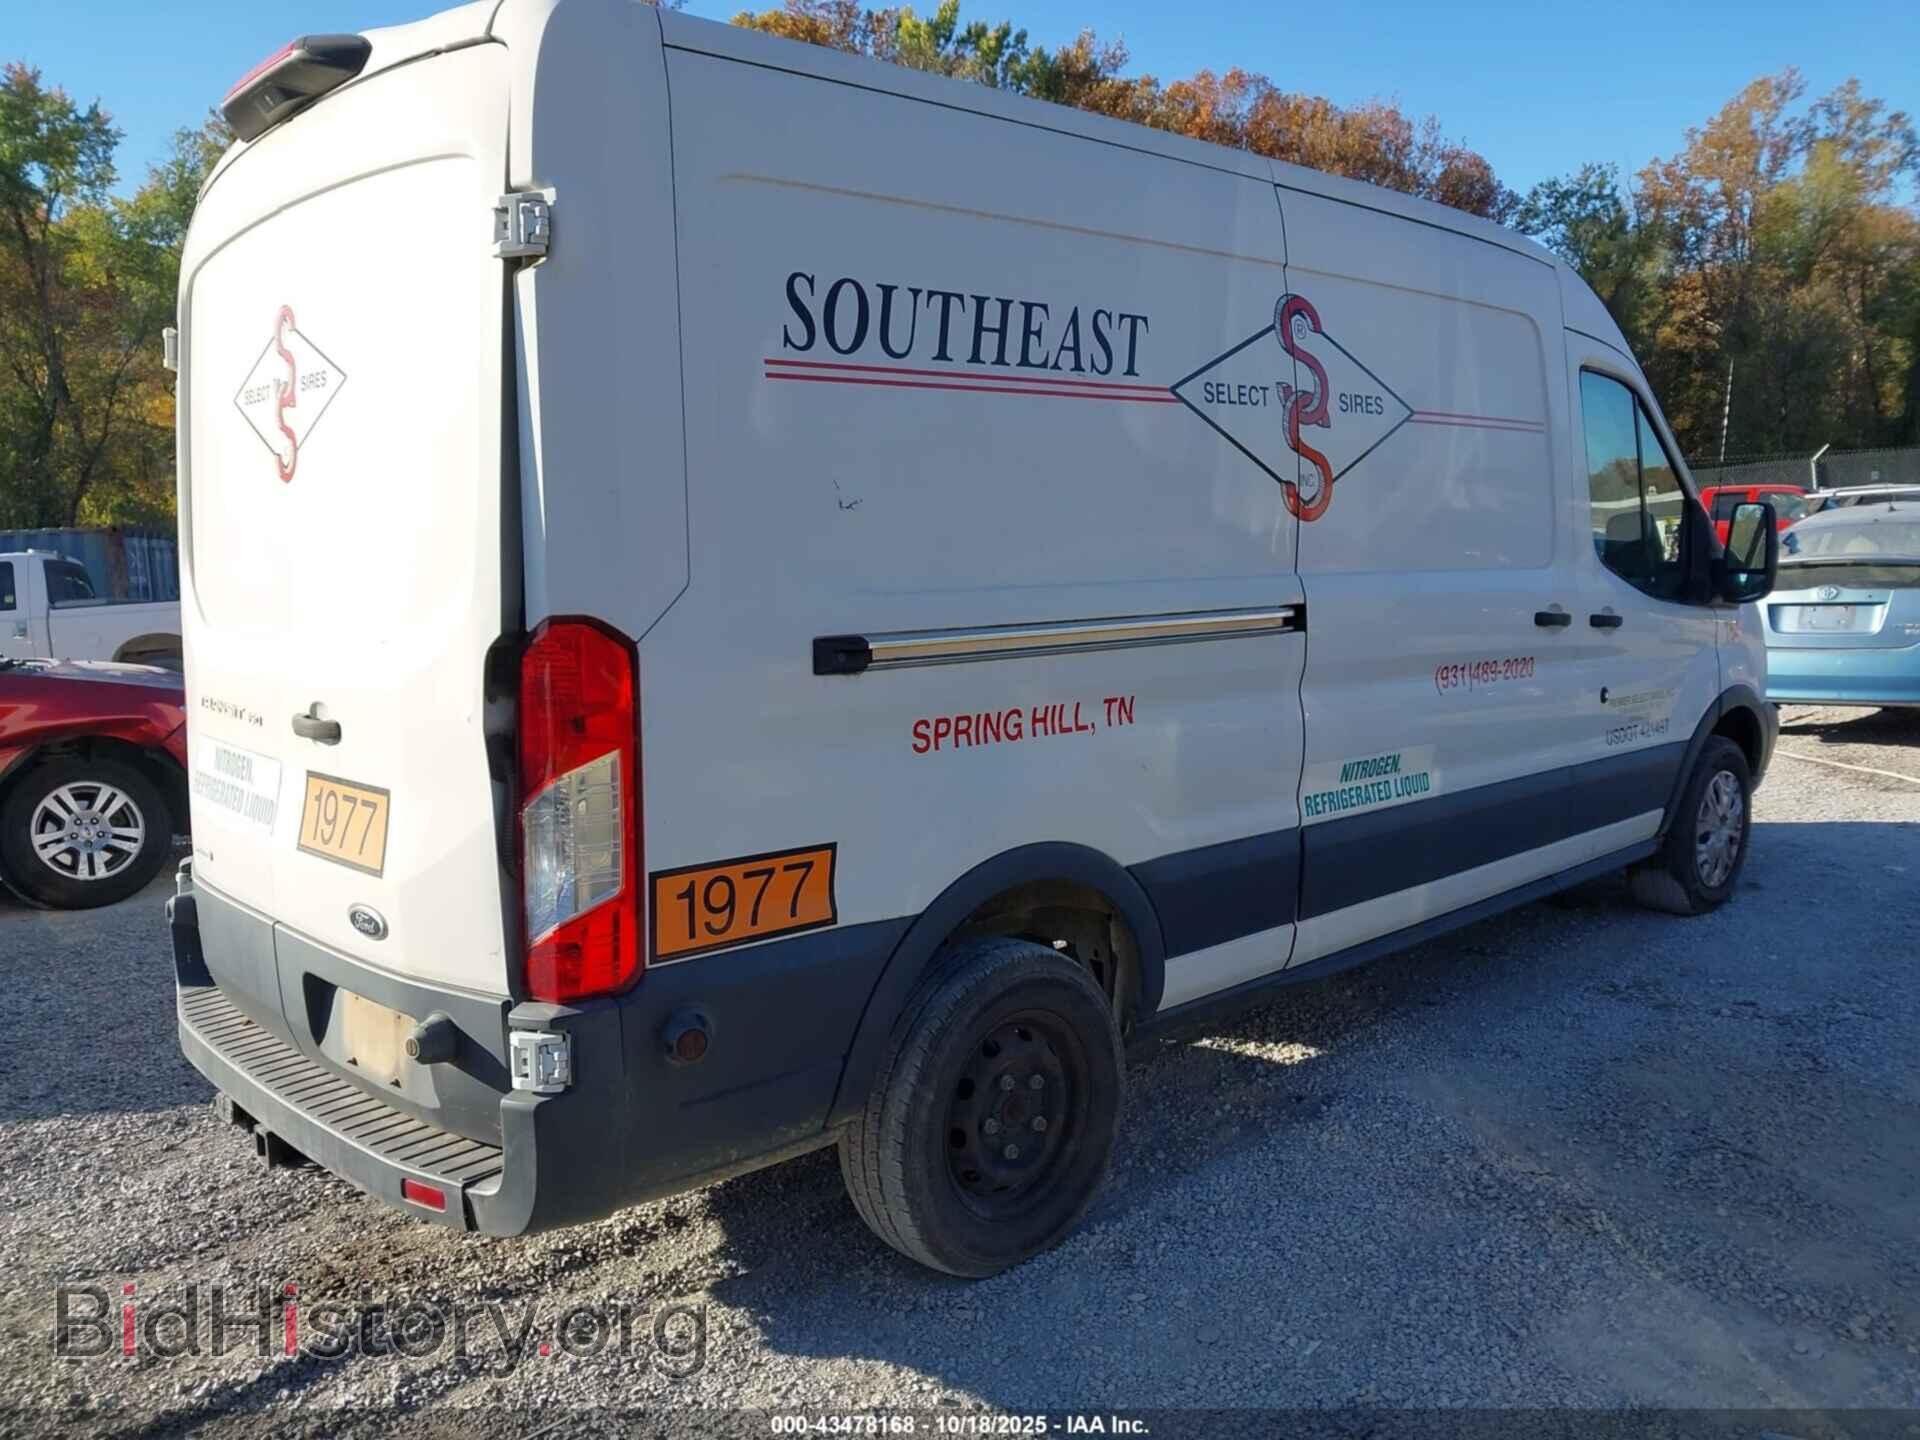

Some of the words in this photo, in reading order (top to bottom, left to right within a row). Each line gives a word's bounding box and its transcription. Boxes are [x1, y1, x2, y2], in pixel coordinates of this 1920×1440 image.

[783, 272, 1149, 377] SOUTHEAST
[300, 370, 327, 391] SIRES
[1203, 382, 1270, 407] SELECT
[1339, 393, 1384, 416] SIRES
[1434, 656, 1535, 696] (931)489-2020
[912, 708, 1024, 754] SPRING
[1031, 702, 1096, 737] HILL,
[1103, 696, 1135, 727] TN
[1303, 780, 1392, 817] REFRIGERATED
[1394, 772, 1431, 798] LIQUID
[313, 787, 378, 857] 1977
[676, 861, 815, 940] 1977
